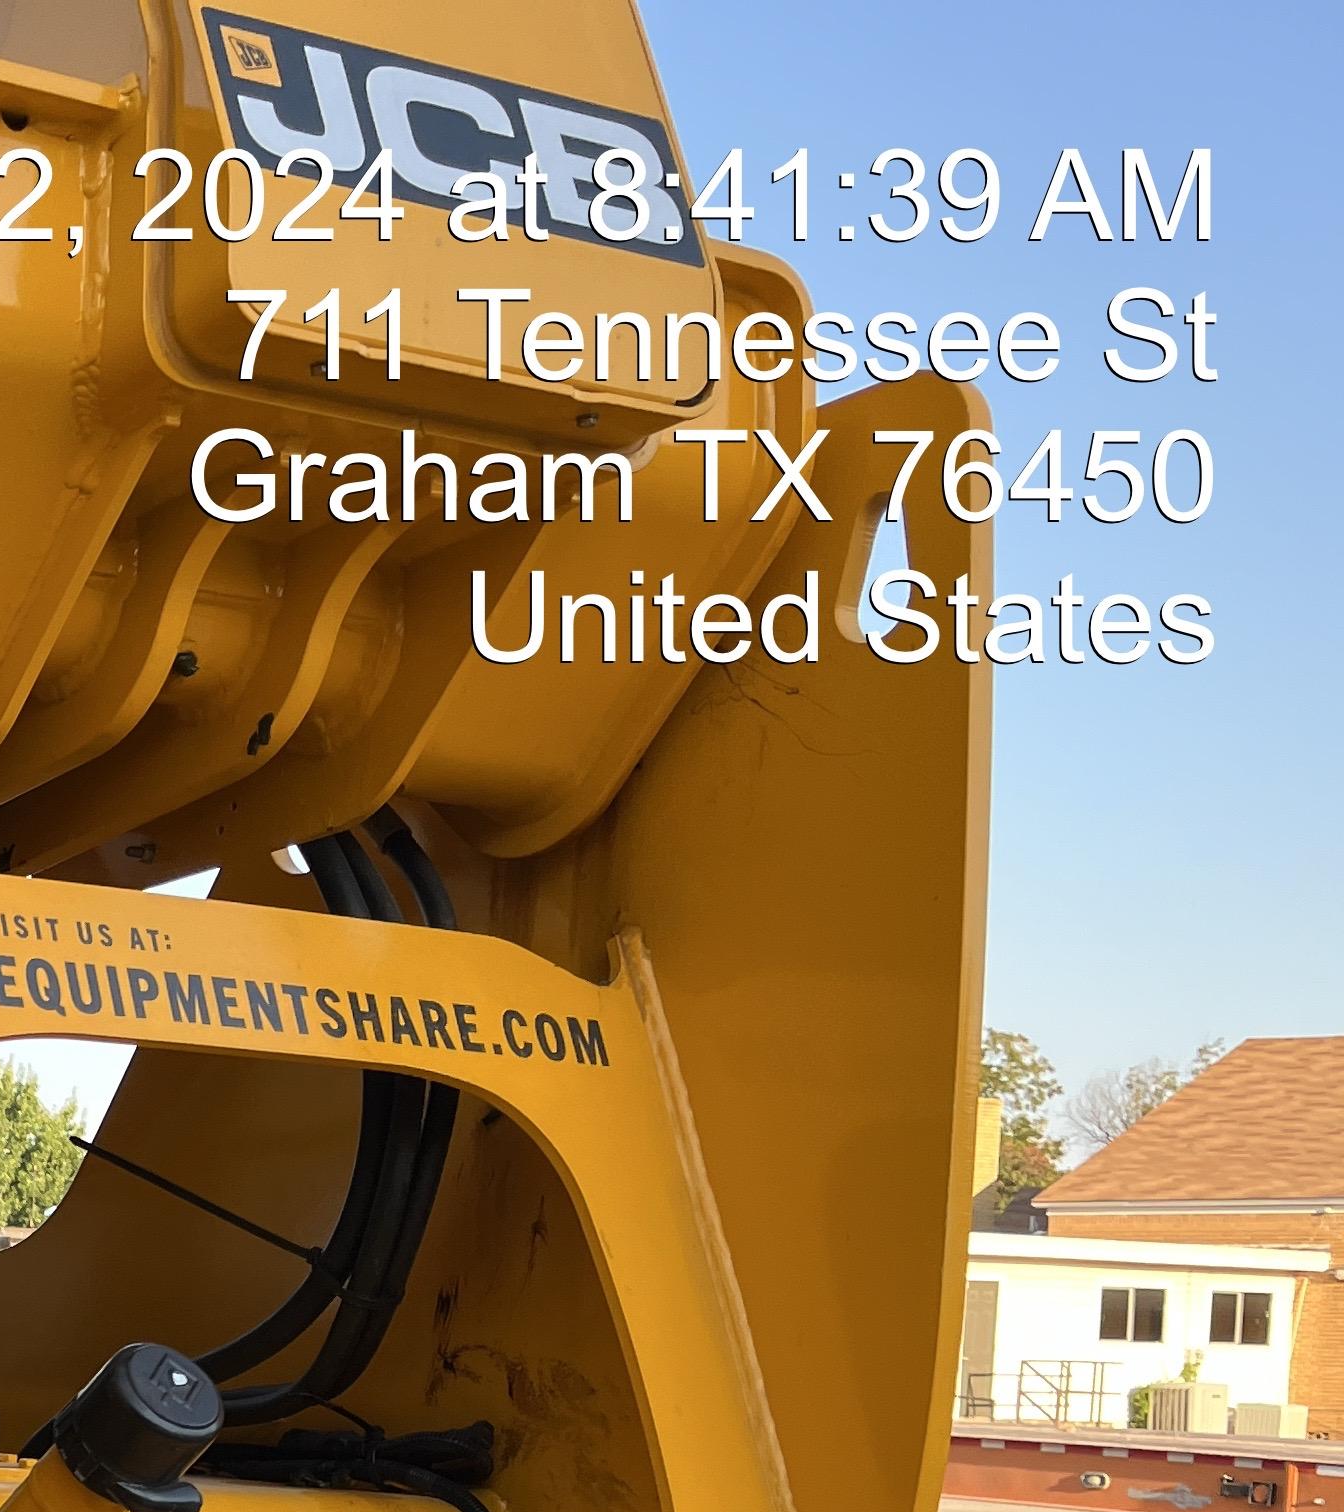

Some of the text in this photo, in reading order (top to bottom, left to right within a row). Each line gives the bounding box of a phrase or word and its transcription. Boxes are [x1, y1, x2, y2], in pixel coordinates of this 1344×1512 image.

[237, 45, 684, 246] JCB
[74, 918, 114, 947] US
[128, 926, 173, 953] AT:
